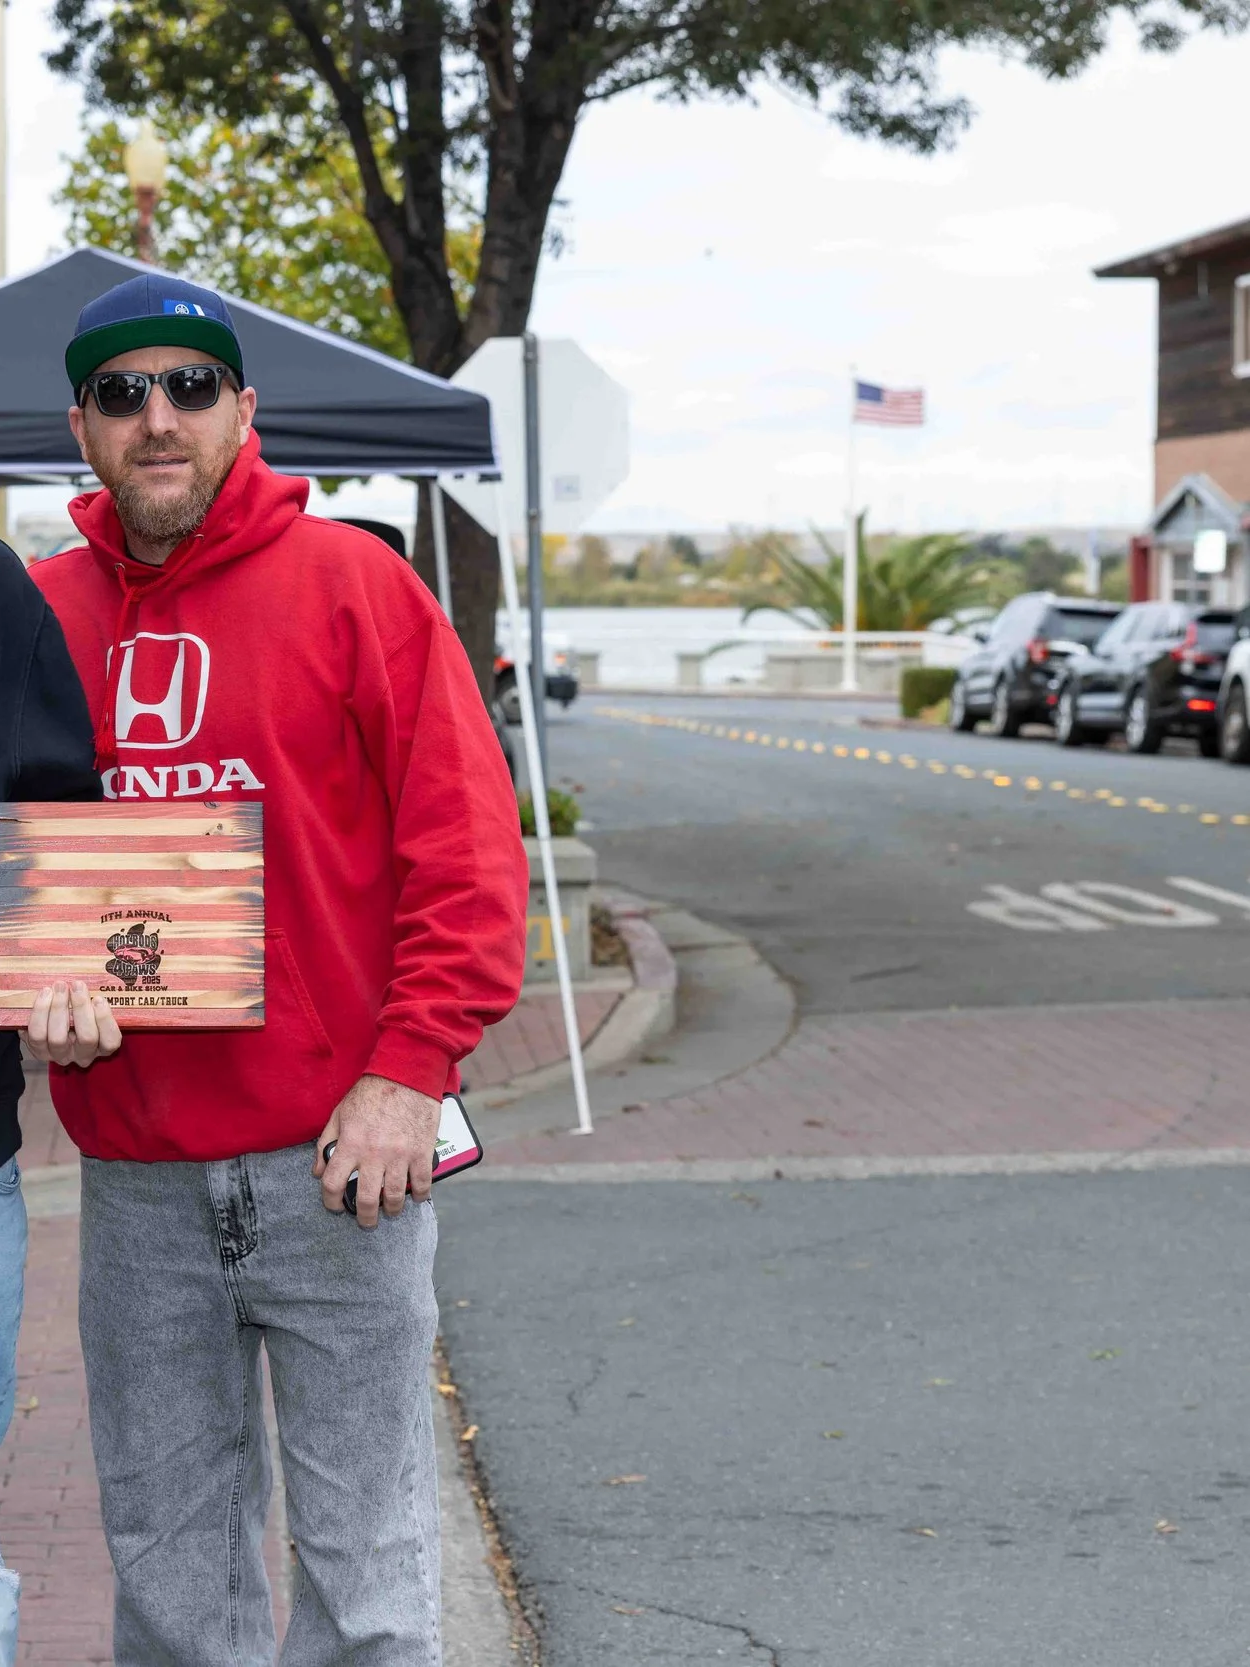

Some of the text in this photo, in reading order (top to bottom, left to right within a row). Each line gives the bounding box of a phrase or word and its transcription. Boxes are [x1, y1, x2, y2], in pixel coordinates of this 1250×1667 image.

[100, 910, 172, 923] 11TH ANNUAL
[125, 963, 157, 976] PAWS
[142, 976, 161, 985] 2025
[138, 996, 188, 1006] CAR/TRUCK
